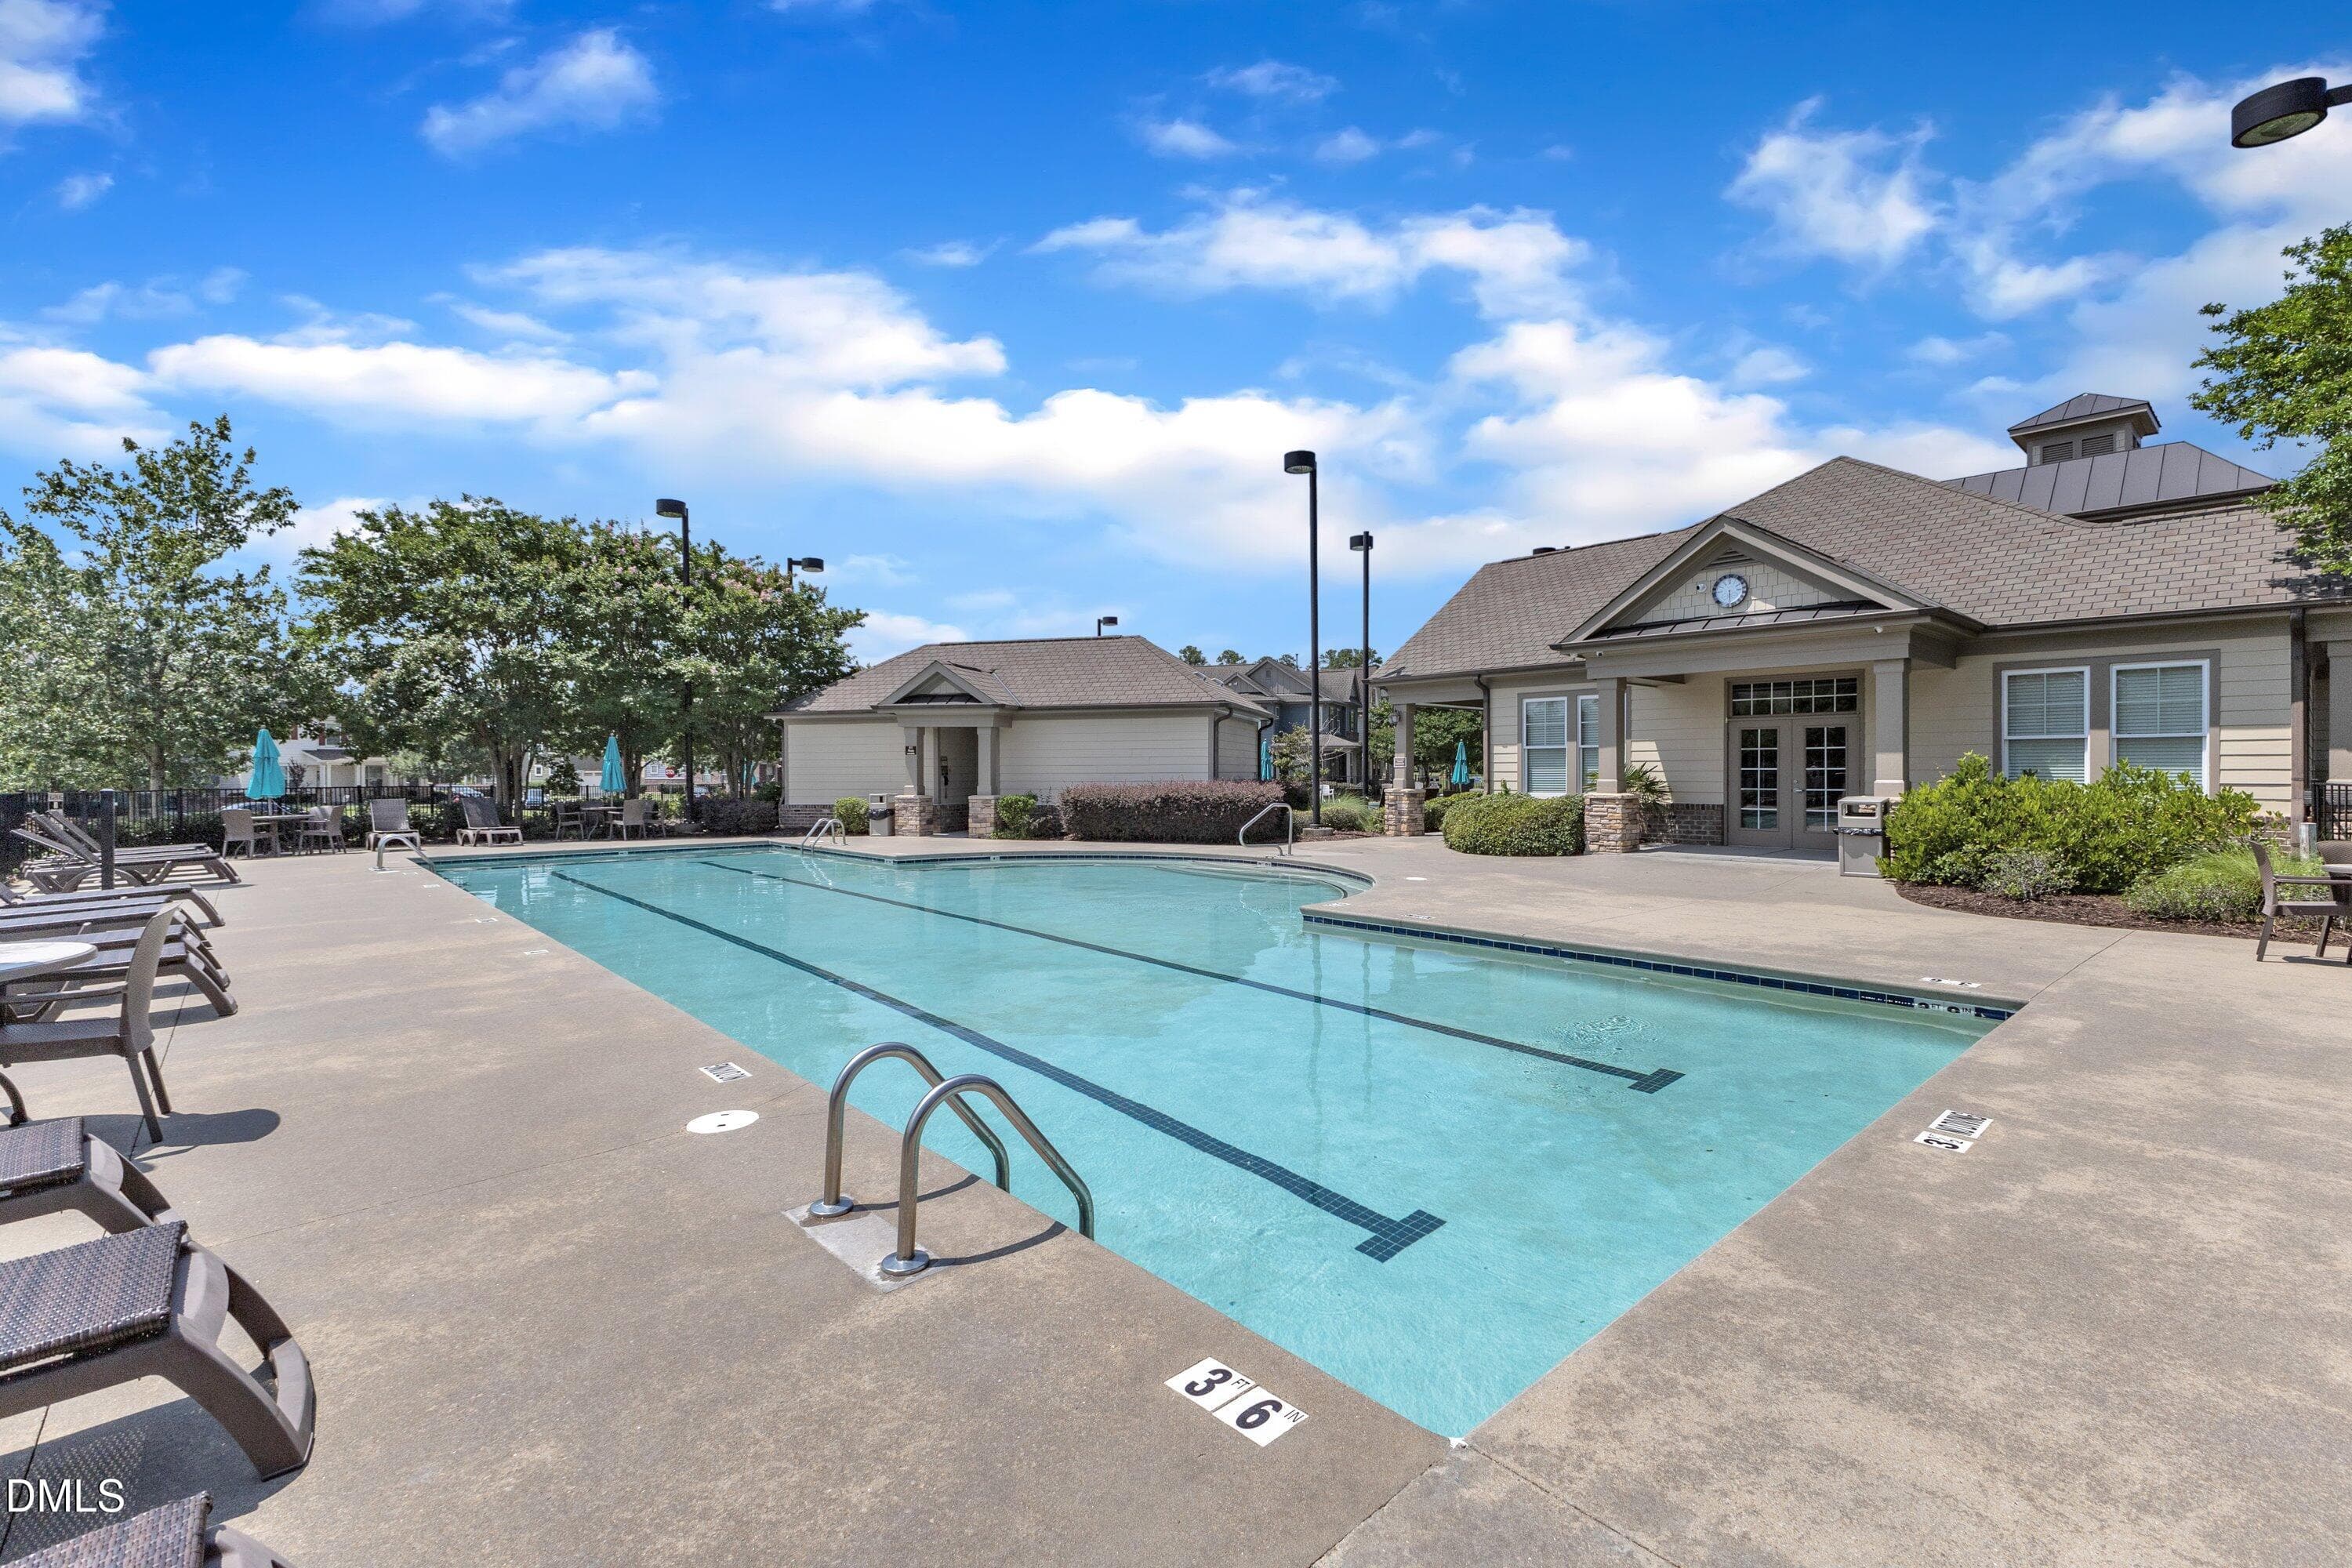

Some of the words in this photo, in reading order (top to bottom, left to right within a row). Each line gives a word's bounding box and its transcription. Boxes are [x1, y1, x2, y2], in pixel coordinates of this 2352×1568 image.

[1185, 1369, 1232, 1396] 3
[1231, 1378, 1250, 1389] FT
[1236, 1399, 1283, 1429] 6
[1284, 1410, 1305, 1423] IN
